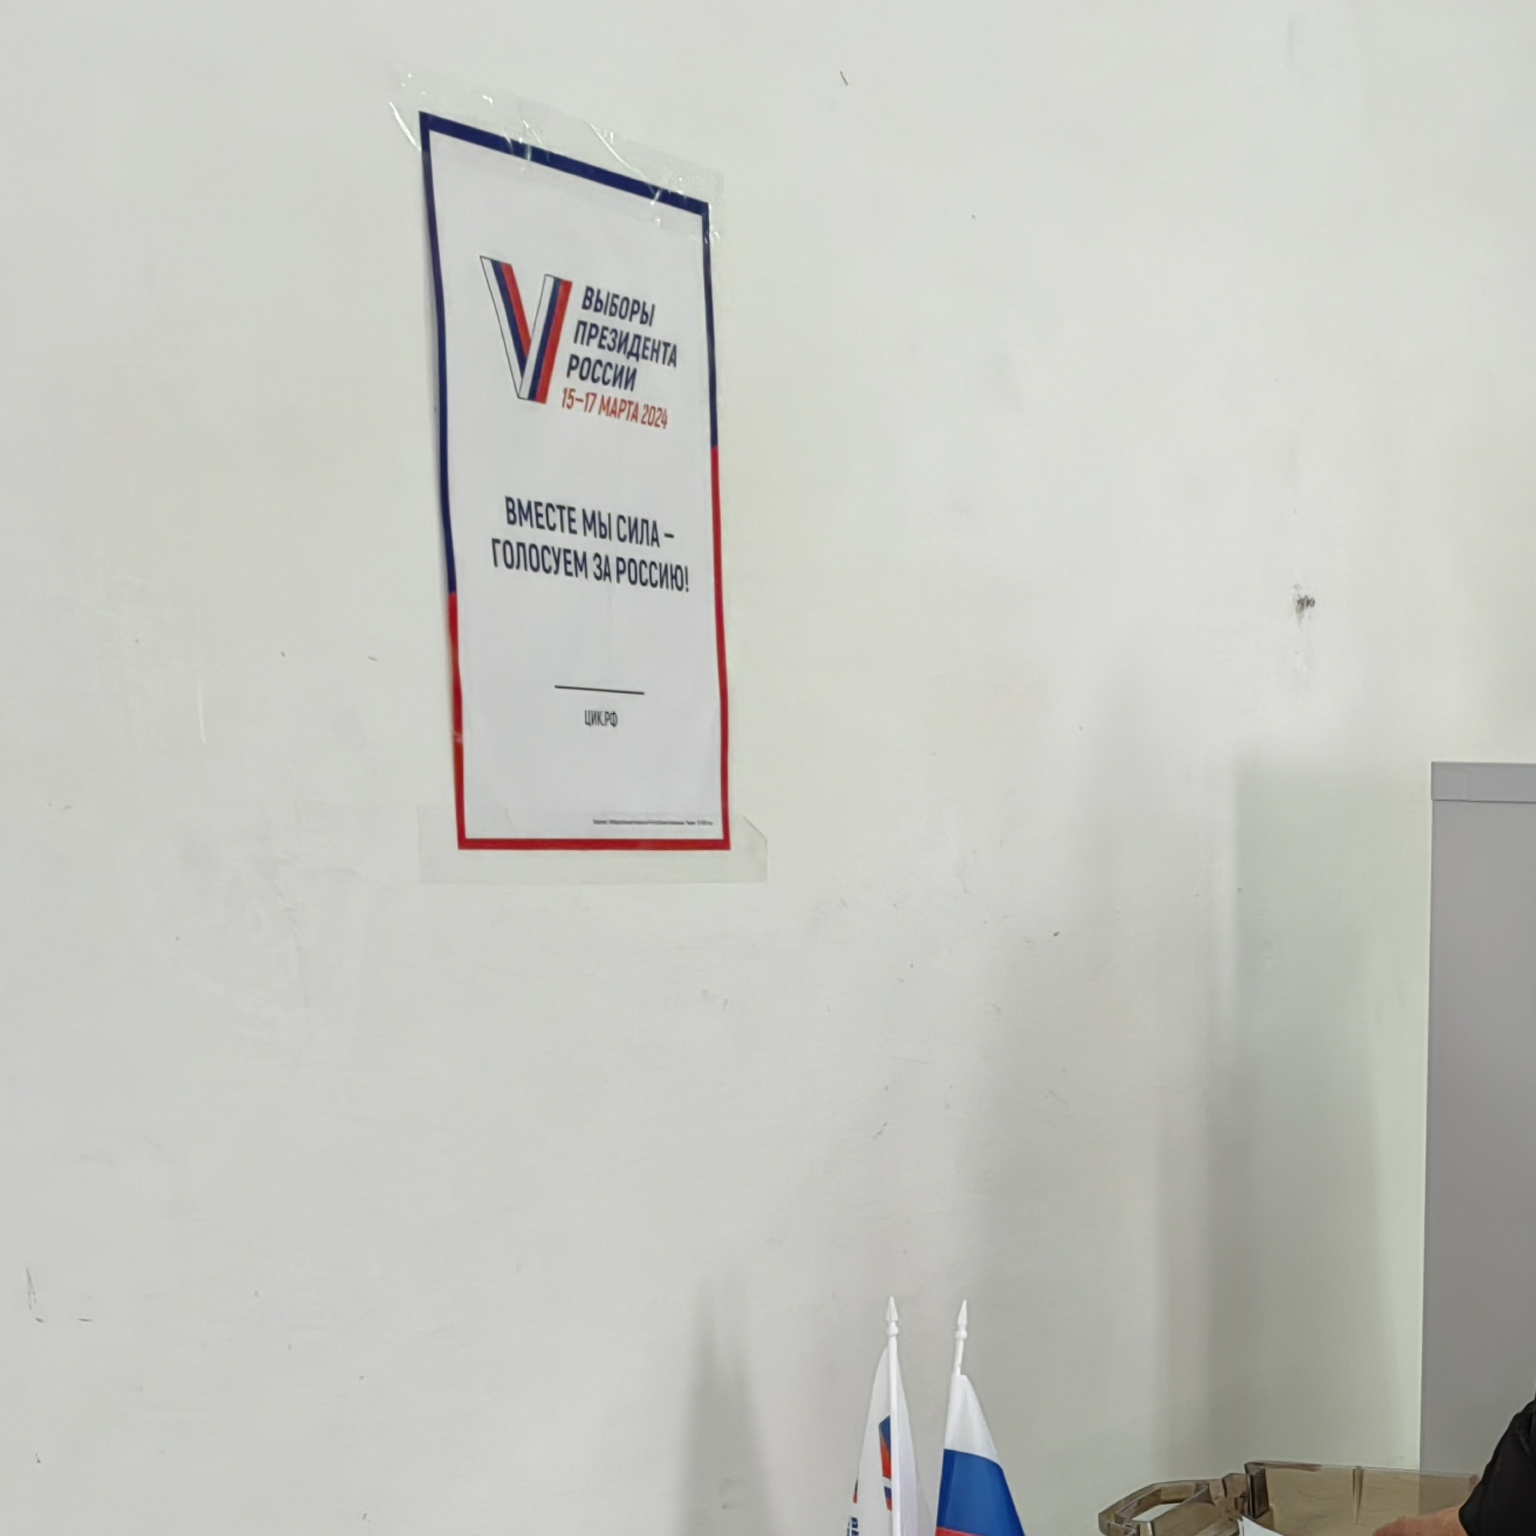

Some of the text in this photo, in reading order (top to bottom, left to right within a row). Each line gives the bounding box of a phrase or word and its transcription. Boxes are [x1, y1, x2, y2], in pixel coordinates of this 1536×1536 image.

[581, 285, 656, 328] ВЫБОРЫ
[573, 319, 678, 368] ПРЕЗИДЕНТА
[566, 353, 638, 392] РОССИИ
[598, 394, 640, 423] МАРТА
[640, 403, 669, 430] 2024
[505, 496, 577, 535] ВМЕСТЕ
[582, 508, 612, 541] МЫ
[616, 514, 660, 548] СИЛА
[491, 538, 690, 593] ГОЛОСУЕМ ЗА РОССИЮ!
